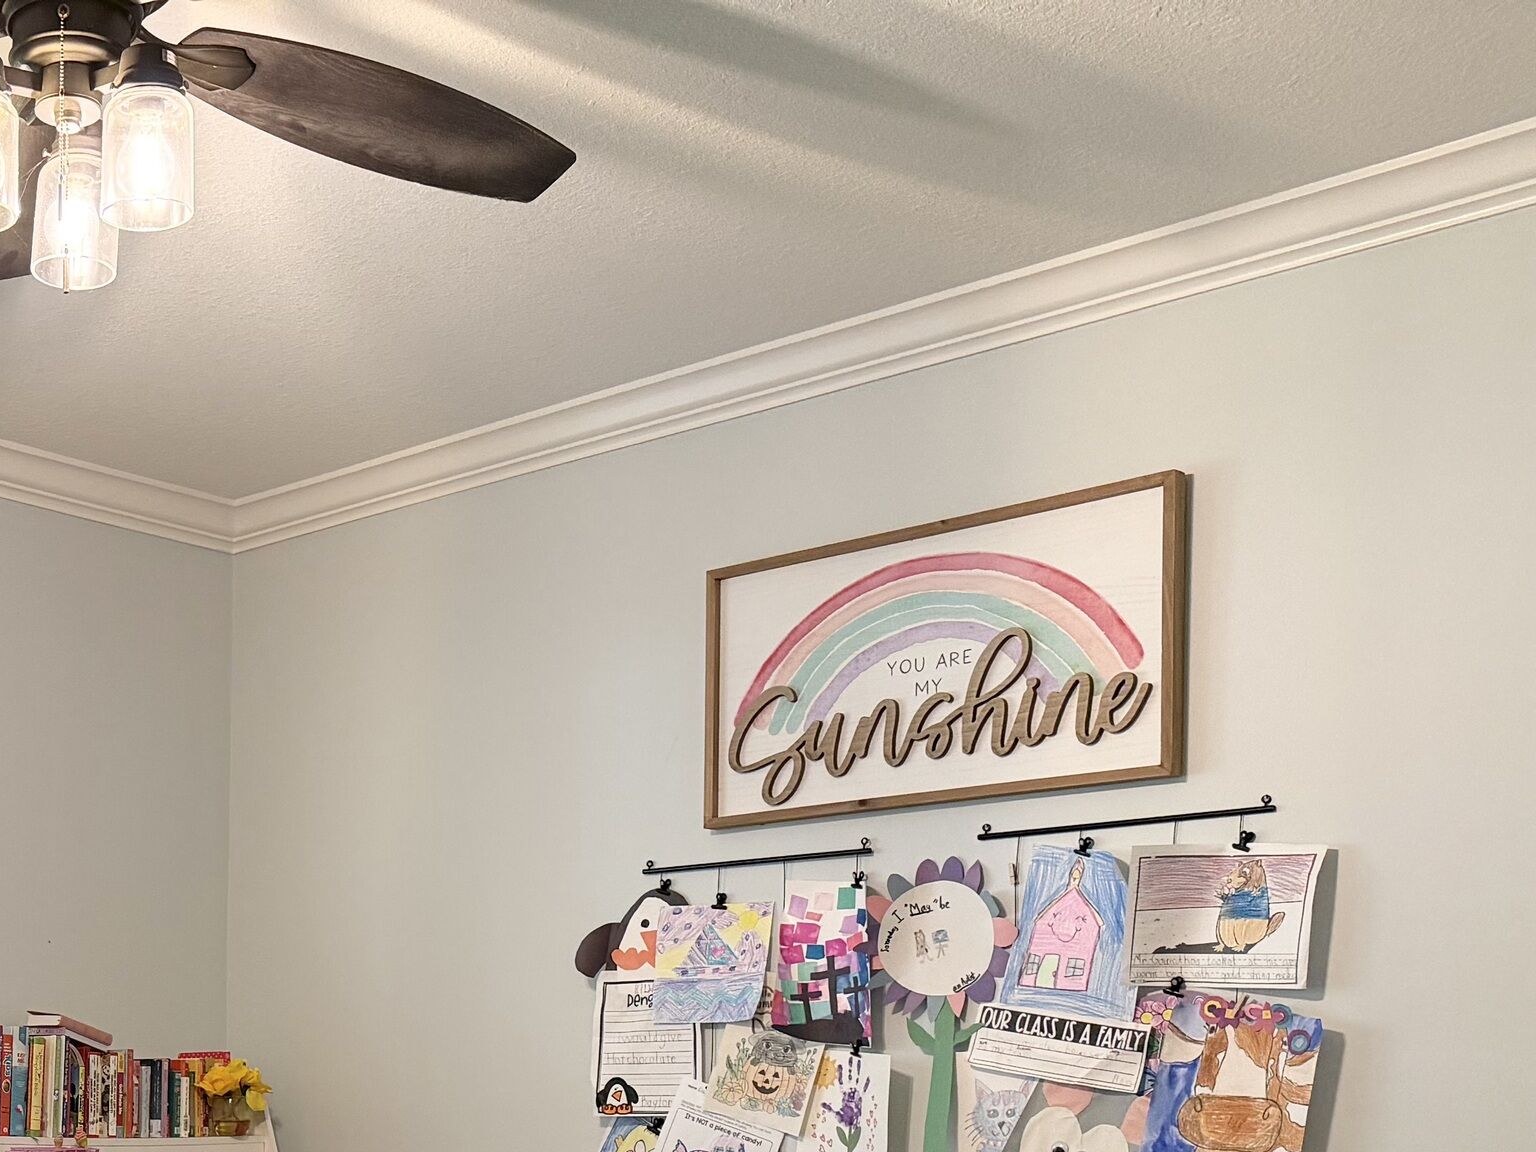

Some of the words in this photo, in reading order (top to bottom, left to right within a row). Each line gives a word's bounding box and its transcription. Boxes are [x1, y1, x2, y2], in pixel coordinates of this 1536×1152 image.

[887, 657, 925, 676] YOU
[935, 649, 972, 669] ARE
[914, 678, 942, 696] MY
[728, 627, 1153, 806] Sunshine
[939, 896, 951, 909] be
[981, 1007, 1012, 1030] OUR
[1015, 1012, 1060, 1039] CLASS
[1062, 1020, 1077, 1042] IS
[1078, 1024, 1091, 1045] A
[695, 1117, 709, 1126] NOT
